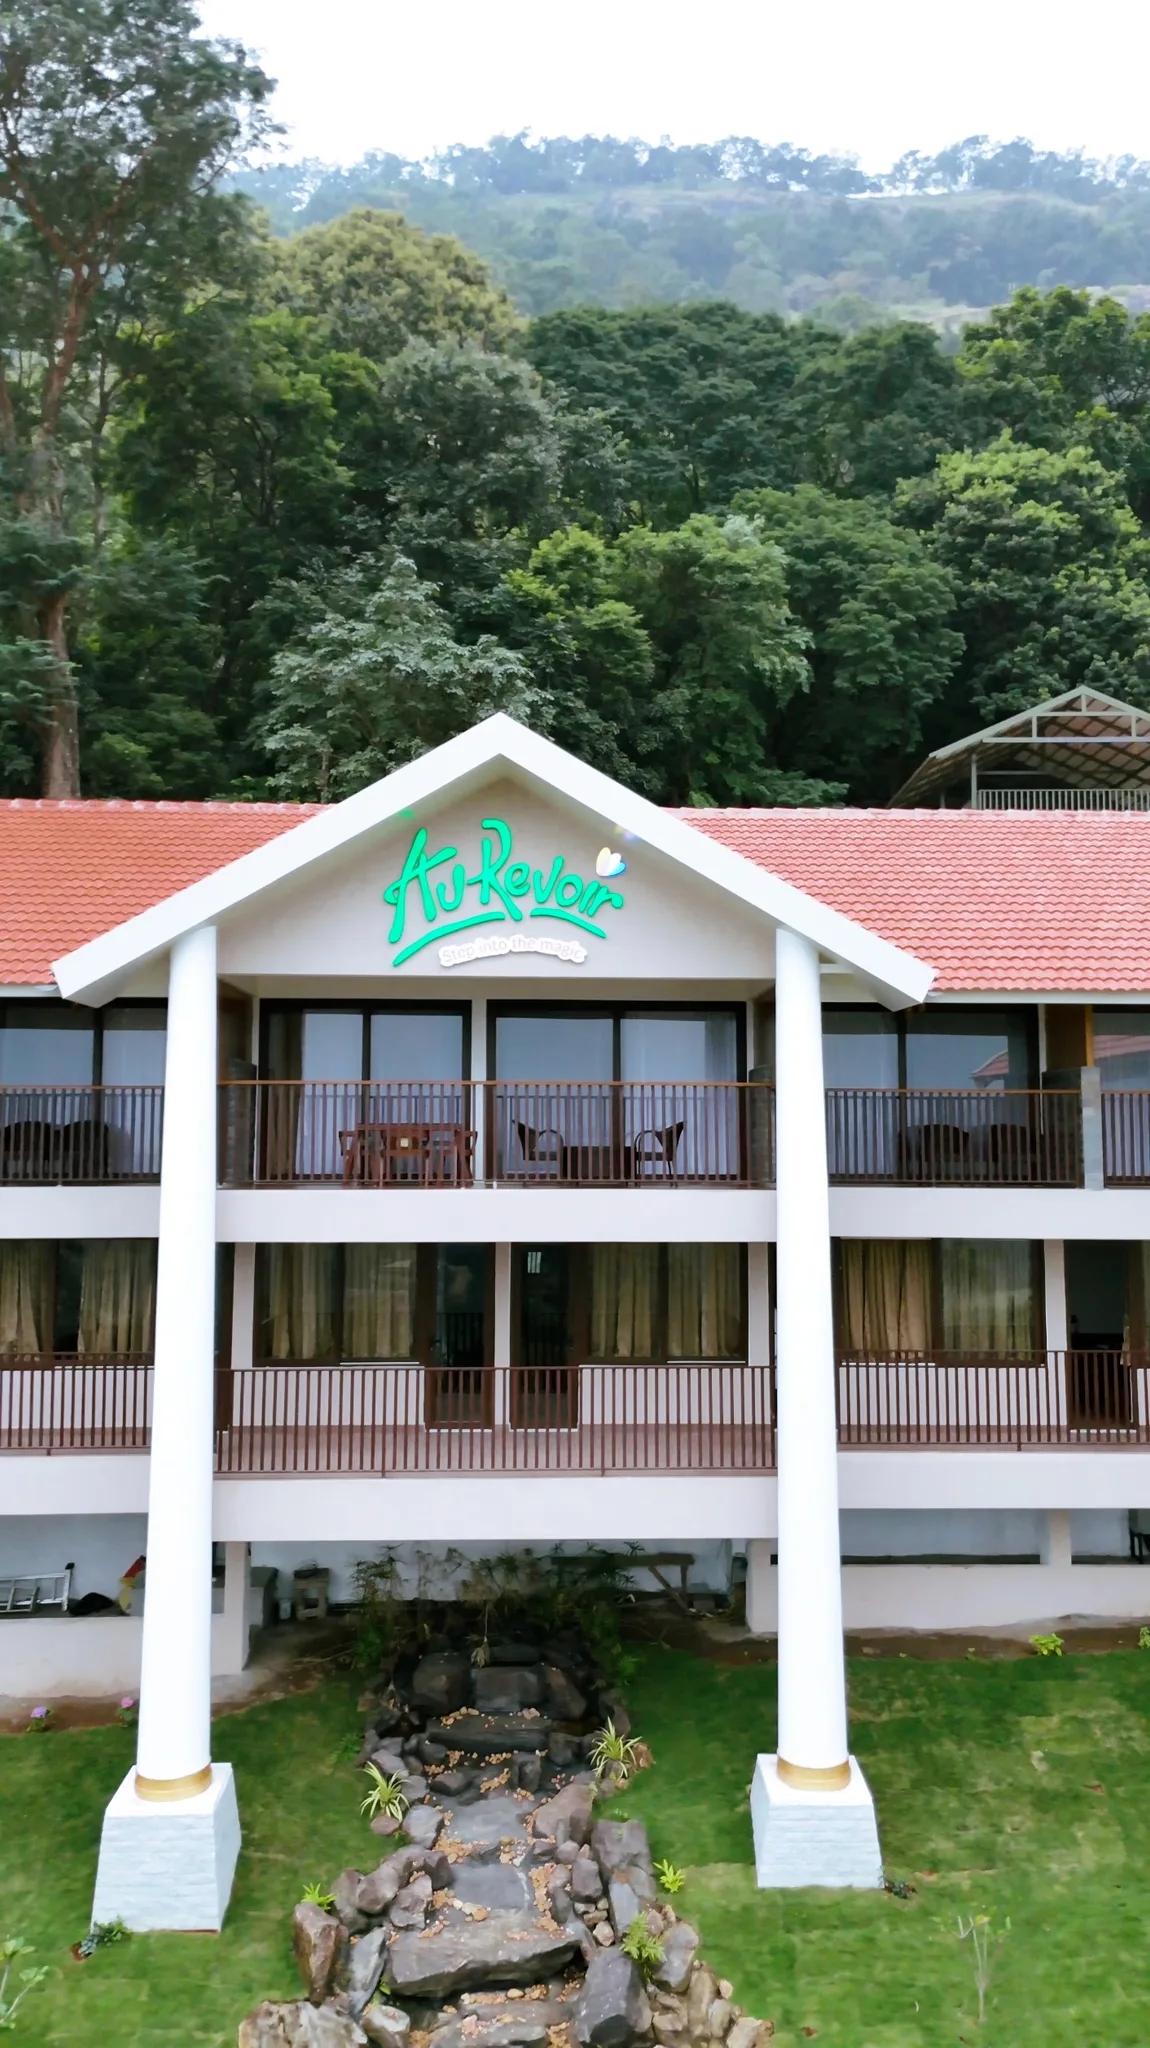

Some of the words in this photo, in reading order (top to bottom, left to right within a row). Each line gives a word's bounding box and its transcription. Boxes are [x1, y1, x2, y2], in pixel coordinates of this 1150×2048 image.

[383, 828, 465, 944] Au
[441, 944, 474, 961] Step
[479, 938, 507, 952] into
[512, 937, 535, 949] the
[540, 939, 583, 958] magic
